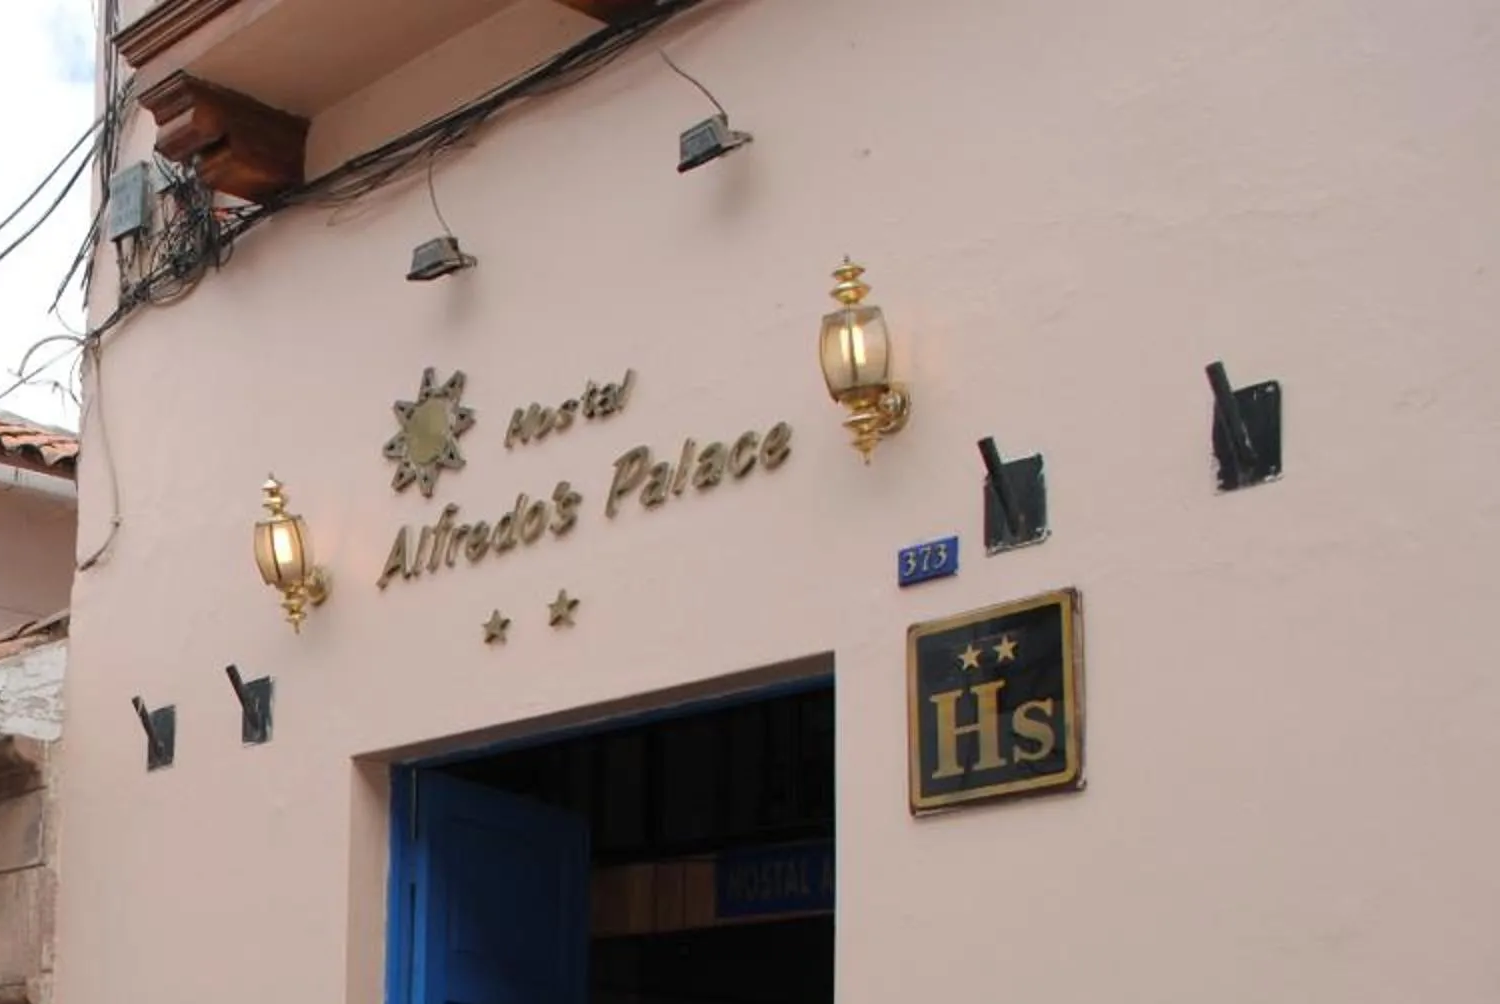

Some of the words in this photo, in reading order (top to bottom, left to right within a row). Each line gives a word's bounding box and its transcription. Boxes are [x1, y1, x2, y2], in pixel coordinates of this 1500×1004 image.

[503, 367, 638, 449] Hostal
[376, 480, 583, 591] Alfredo's
[605, 421, 793, 519] Palace
[902, 542, 949, 577] 373
[929, 678, 1056, 780] Hs
[727, 856, 806, 902] HOSTAL
